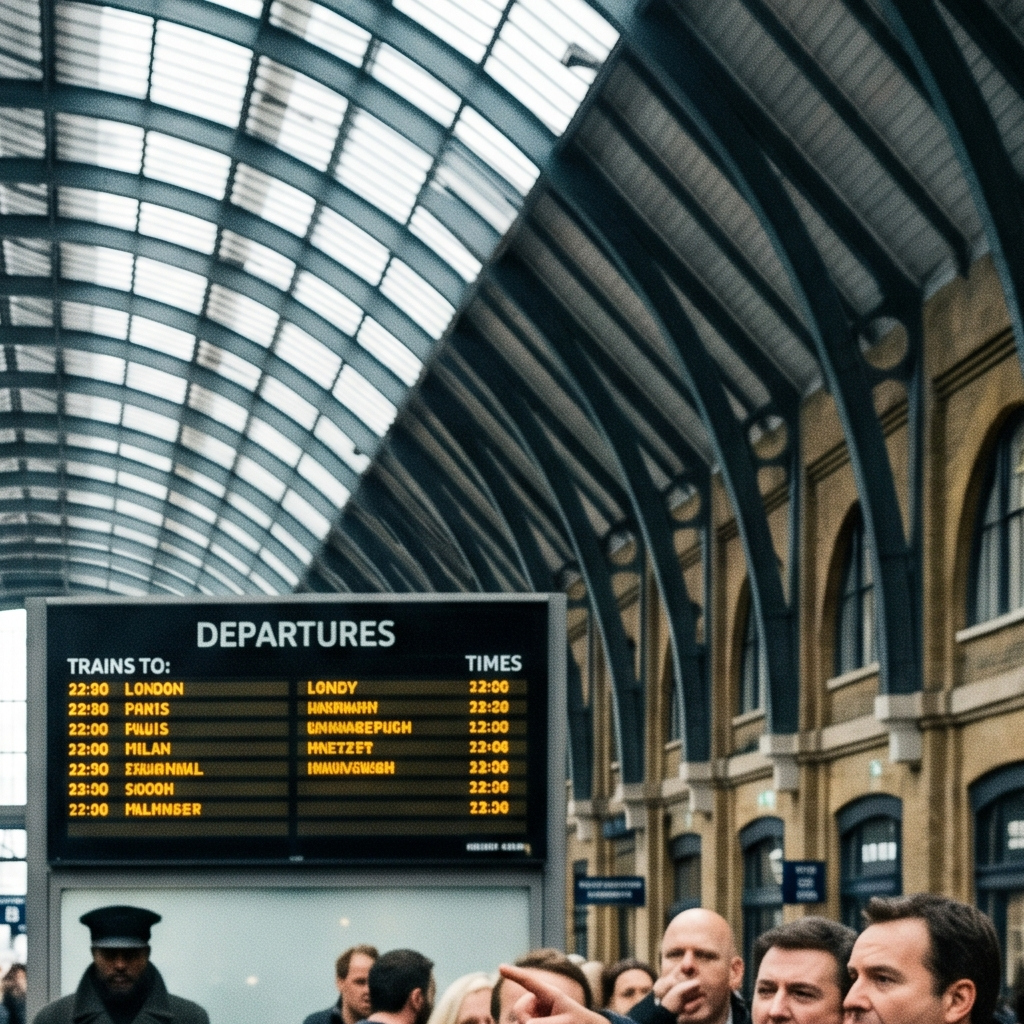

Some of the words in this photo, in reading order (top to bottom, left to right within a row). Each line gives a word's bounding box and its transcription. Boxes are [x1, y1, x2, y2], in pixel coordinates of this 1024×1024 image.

[197, 619, 396, 648] DEPARTURES
[66, 657, 136, 675] TRAINS
[139, 657, 171, 675] TO:
[465, 654, 523, 672] TIMES
[124, 681, 184, 696] LONDON
[307, 680, 358, 695] LONDY
[67, 722, 110, 737] 22:00
[67, 742, 110, 757] 22:00
[124, 742, 171, 756] MILAN
